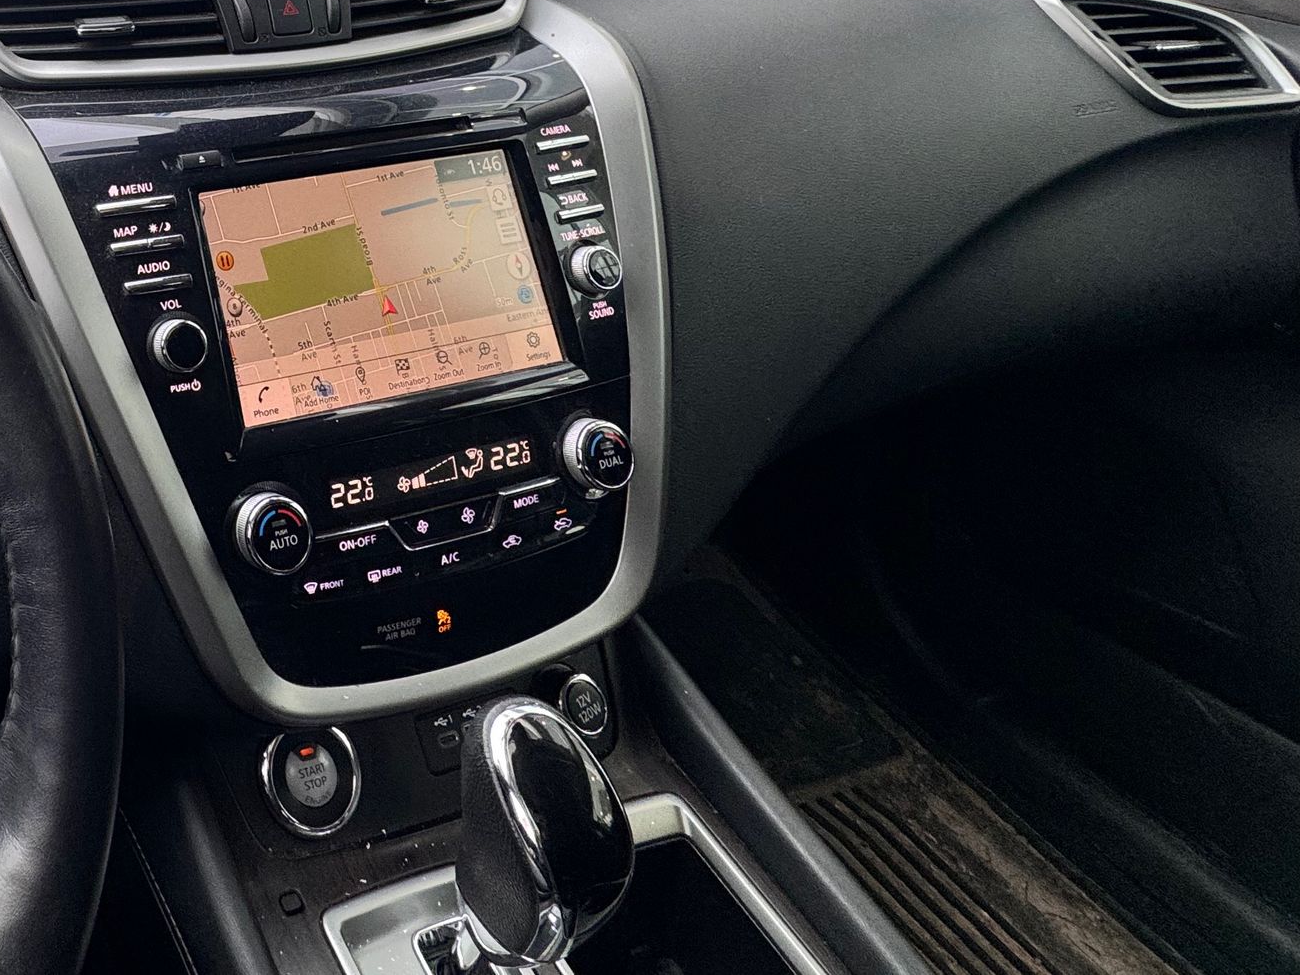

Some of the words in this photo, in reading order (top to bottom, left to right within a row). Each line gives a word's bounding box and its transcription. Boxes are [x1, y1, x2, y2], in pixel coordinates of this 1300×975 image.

[540, 124, 571, 136] CAMERA
[467, 156, 501, 175] 1:46
[376, 171, 390, 182] 1st
[390, 169, 405, 180] Ave
[120, 182, 154, 195] MENU
[567, 192, 588, 203] BACK
[113, 225, 138, 238] MAP
[302, 223, 318, 234] 2nd
[320, 219, 336, 230] Ave
[357, 237, 374, 266] Broad
[452, 246, 468, 265] Ross
[137, 260, 171, 275] AUDIO
[422, 265, 437, 275] 4th
[461, 257, 473, 273] Ave
[426, 276, 442, 286] Ave
[160, 298, 182, 311] VOL
[326, 296, 342, 307] 4th
[342, 293, 359, 304] Ave
[238, 294, 269, 334] Terminal
[507, 310, 535, 322] Eastern
[589, 306, 614, 320] SOUND
[227, 318, 241, 328] 4th
[229, 329, 246, 339] Ave
[324, 321, 337, 352] Scarth
[297, 341, 312, 350] 5th
[458, 346, 473, 355] Ave
[301, 351, 317, 361] Ave
[526, 351, 551, 362] Settings
[477, 363, 494, 372] Zoom
[434, 372, 451, 381] Zoom
[452, 368, 465, 377] Out
[170, 382, 190, 393] PUSH
[292, 385, 307, 394] 6th
[304, 398, 318, 408] Add
[319, 395, 339, 405] Home
[253, 407, 279, 418] Phone
[599, 455, 624, 469] DUAL
[513, 494, 539, 509] MODE
[274, 528, 288, 536] PUSH
[269, 534, 298, 551] AUTO
[441, 551, 460, 565] A/C
[381, 566, 402, 577] REAR
[319, 579, 344, 591] FRONT
[377, 617, 422, 634] PASSENGER
[438, 624, 451, 633] OFF
[385, 631, 400, 641] AIR
[575, 691, 592, 707] 12V
[579, 702, 602, 724] 120W
[298, 763, 326, 779] START
[304, 776, 327, 791] STOP
